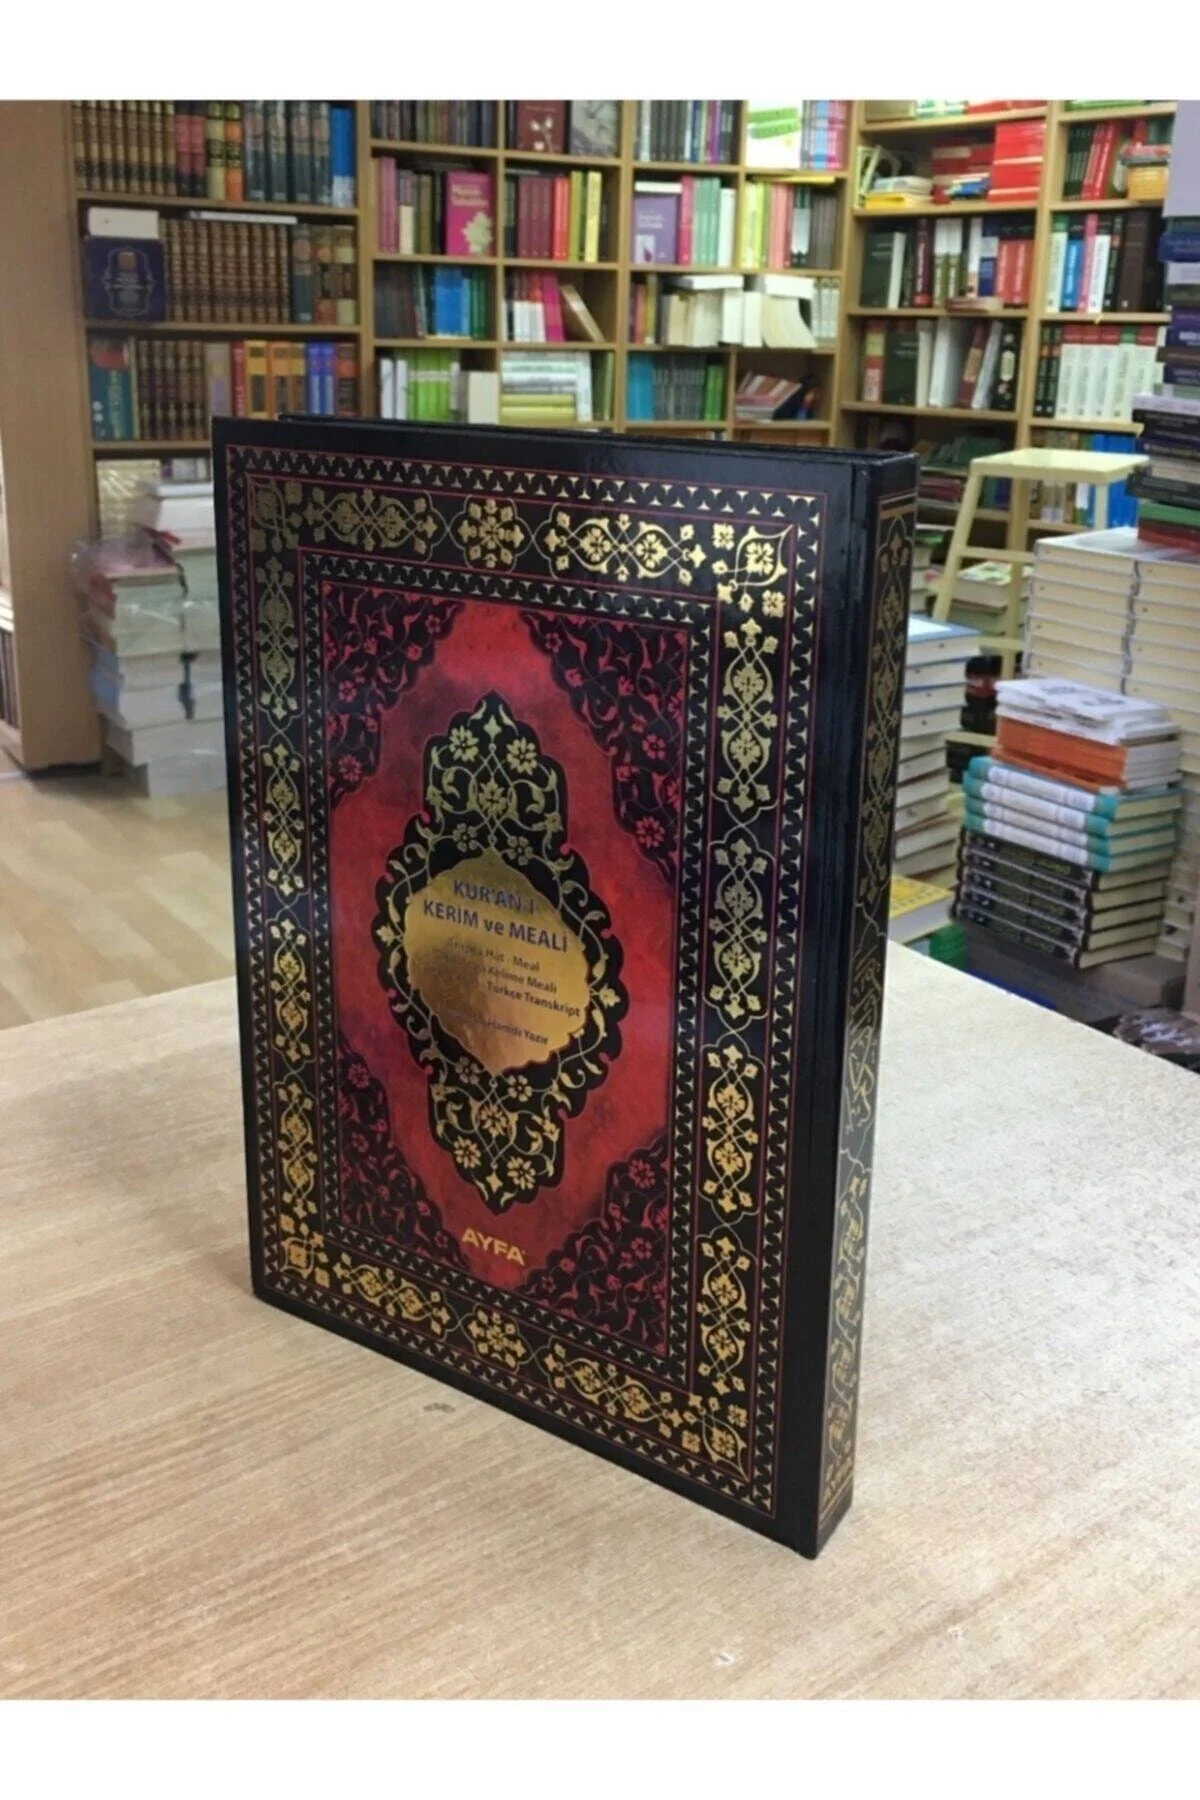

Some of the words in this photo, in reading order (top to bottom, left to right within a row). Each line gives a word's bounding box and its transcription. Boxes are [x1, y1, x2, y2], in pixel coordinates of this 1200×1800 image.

[483, 919, 504, 936] ve
[509, 920, 568, 953] MEALİ
[513, 955, 540, 972] Meal
[523, 991, 580, 1018] Transkript
[462, 1227, 526, 1266] AYFA
